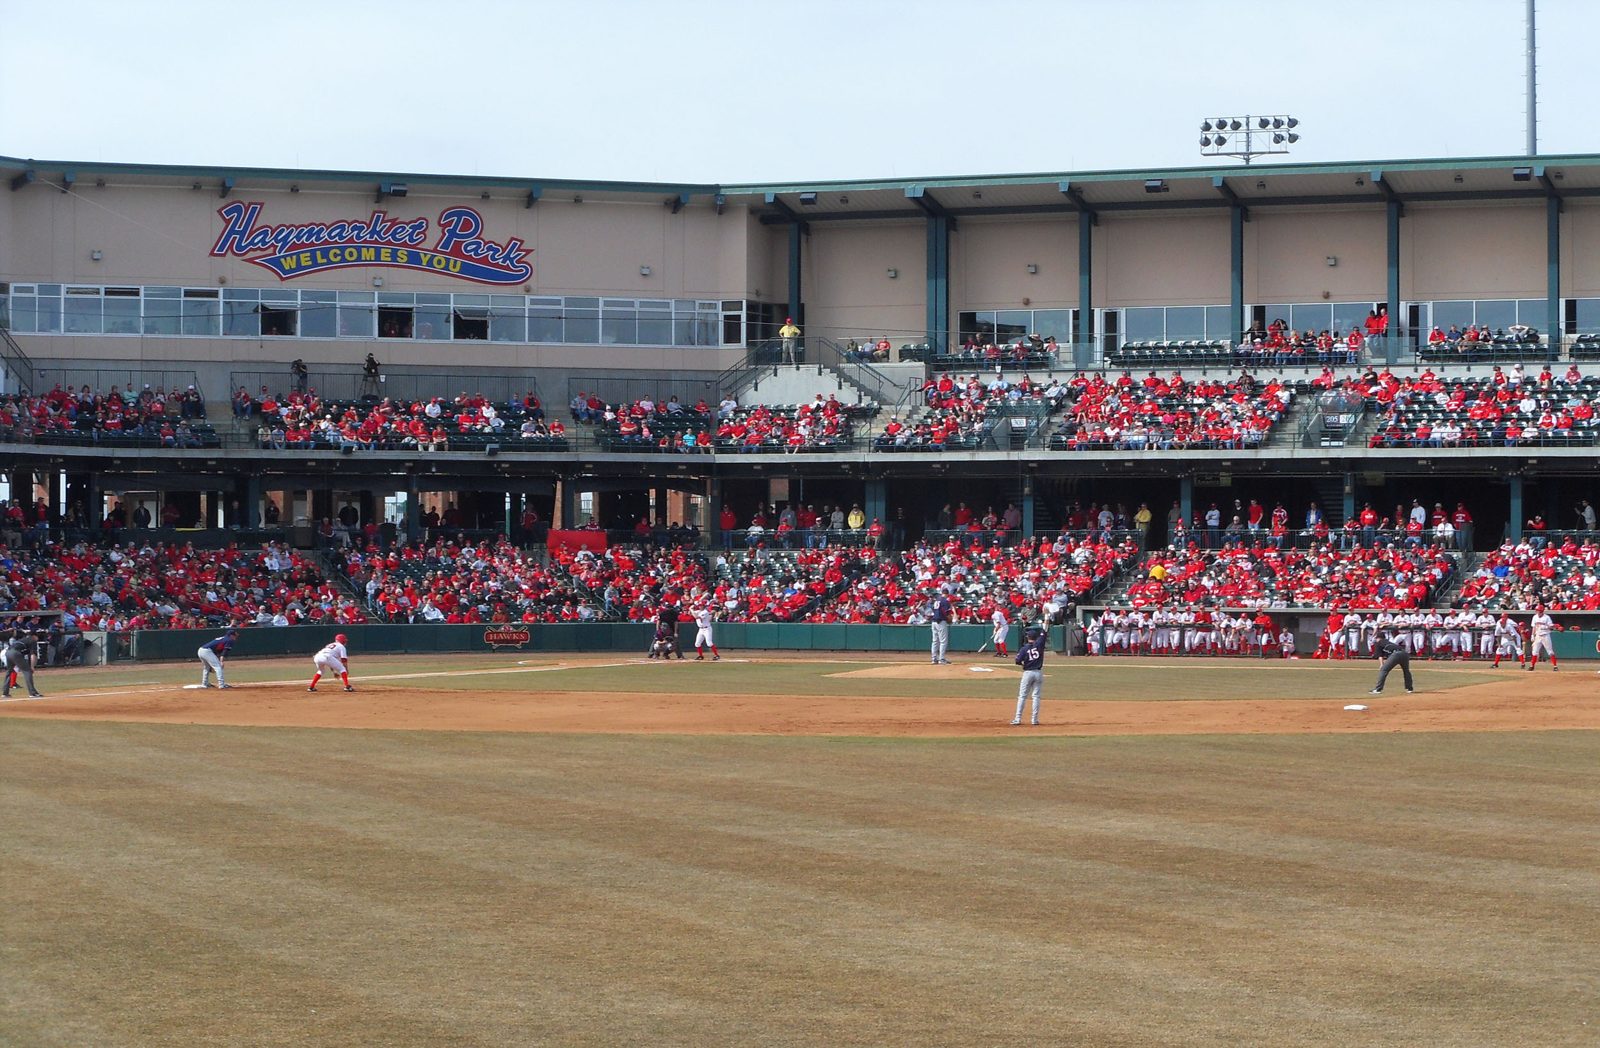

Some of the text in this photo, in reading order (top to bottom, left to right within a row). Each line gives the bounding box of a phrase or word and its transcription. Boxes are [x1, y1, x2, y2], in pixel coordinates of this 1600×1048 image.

[212, 202, 532, 270] Haymarket Park
[281, 247, 462, 273] WELCOMES YOU
[1026, 648, 1040, 661] 15
